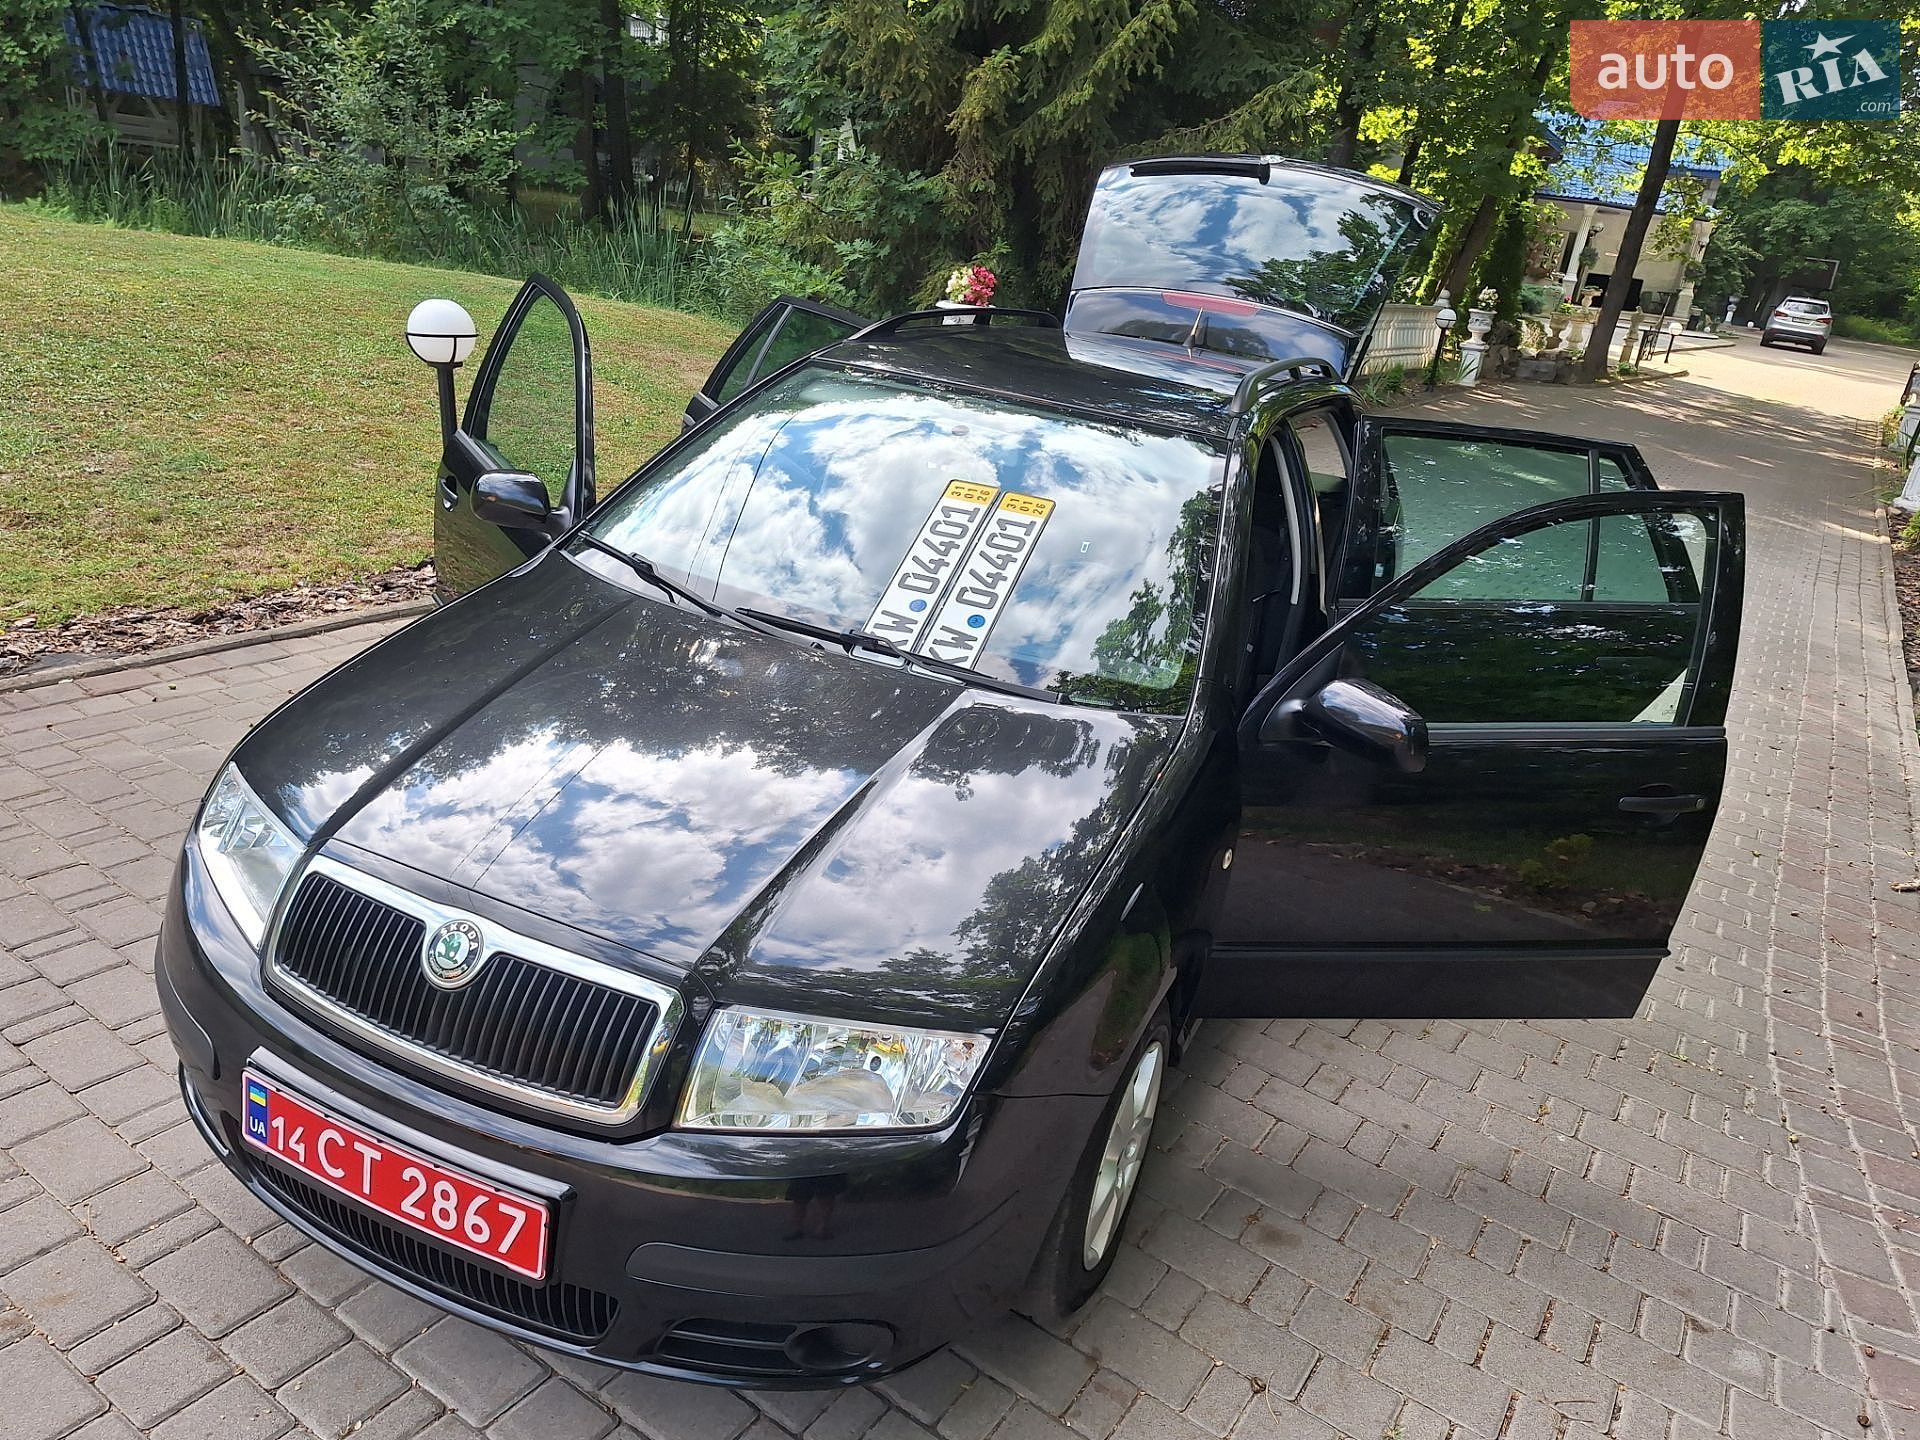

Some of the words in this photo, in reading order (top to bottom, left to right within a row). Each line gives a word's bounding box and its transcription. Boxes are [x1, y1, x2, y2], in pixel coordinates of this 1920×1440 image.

[951, 486, 965, 497] 31
[1006, 498, 1020, 509] 31
[897, 505, 980, 595] 04401
[955, 518, 1037, 610] 04401
[249, 1116, 266, 1138] UA
[271, 1115, 305, 1163] 14
[317, 1128, 382, 1195] CT
[400, 1167, 527, 1254] 2867
